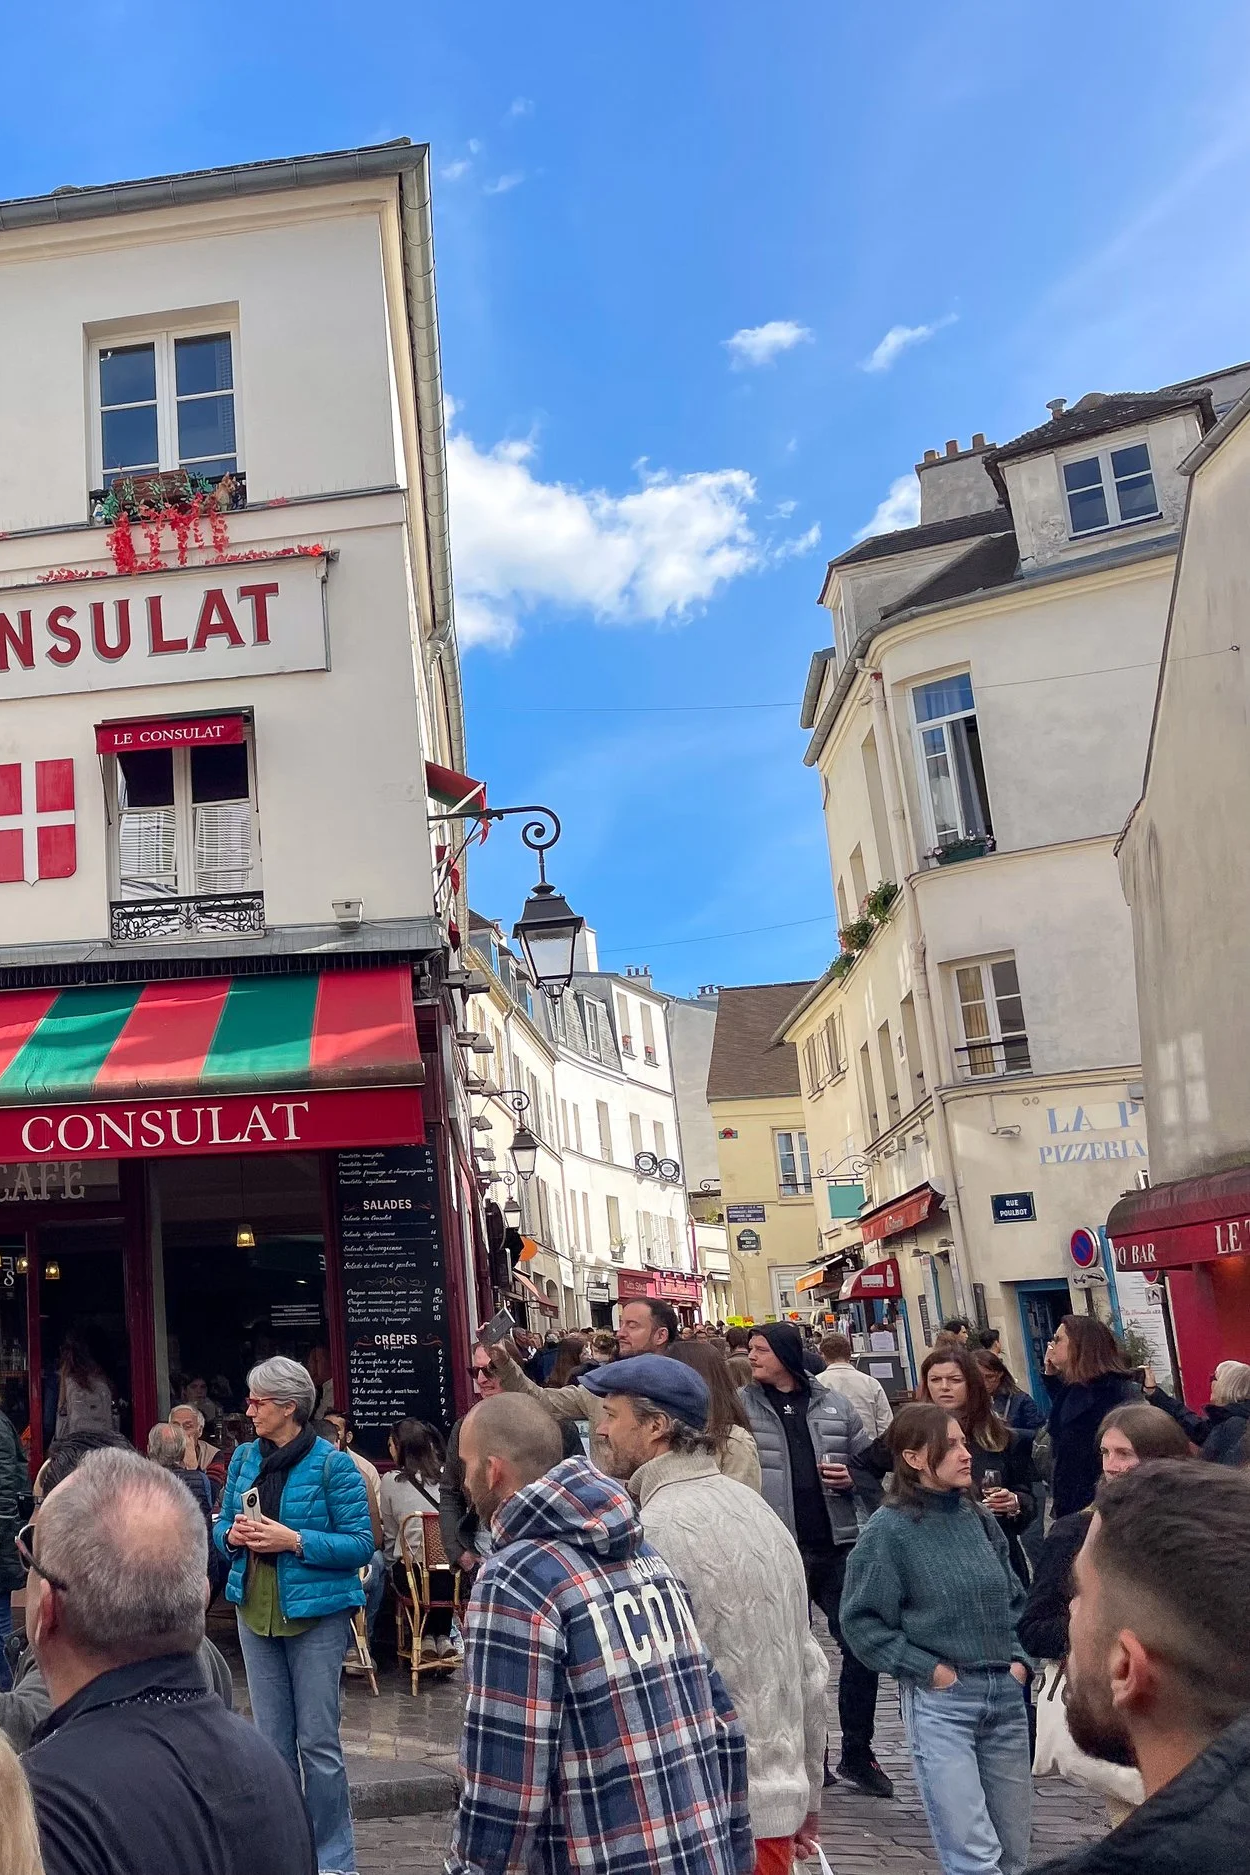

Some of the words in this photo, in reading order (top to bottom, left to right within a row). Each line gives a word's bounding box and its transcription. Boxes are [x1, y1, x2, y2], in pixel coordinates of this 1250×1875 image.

[114, 733, 133, 746] LE
[139, 725, 224, 744] CONSULAT
[20, 1102, 310, 1155] CONSULAT
[1047, 1105, 1095, 1134] LA
[1038, 1139, 1148, 1165] PIZZERIA
[362, 1199, 413, 1210] SALADES
[999, 1208, 1028, 1217] POULBOT
[1005, 1199, 1019, 1207] RUE
[1214, 1222, 1243, 1255] LE
[1132, 1243, 1157, 1264] BAR
[374, 1333, 418, 1345] CRÊPES
[439, 1386, 445, 1394] 7
[440, 1397, 445, 1405] 9
[587, 1578, 703, 1678] ICON
